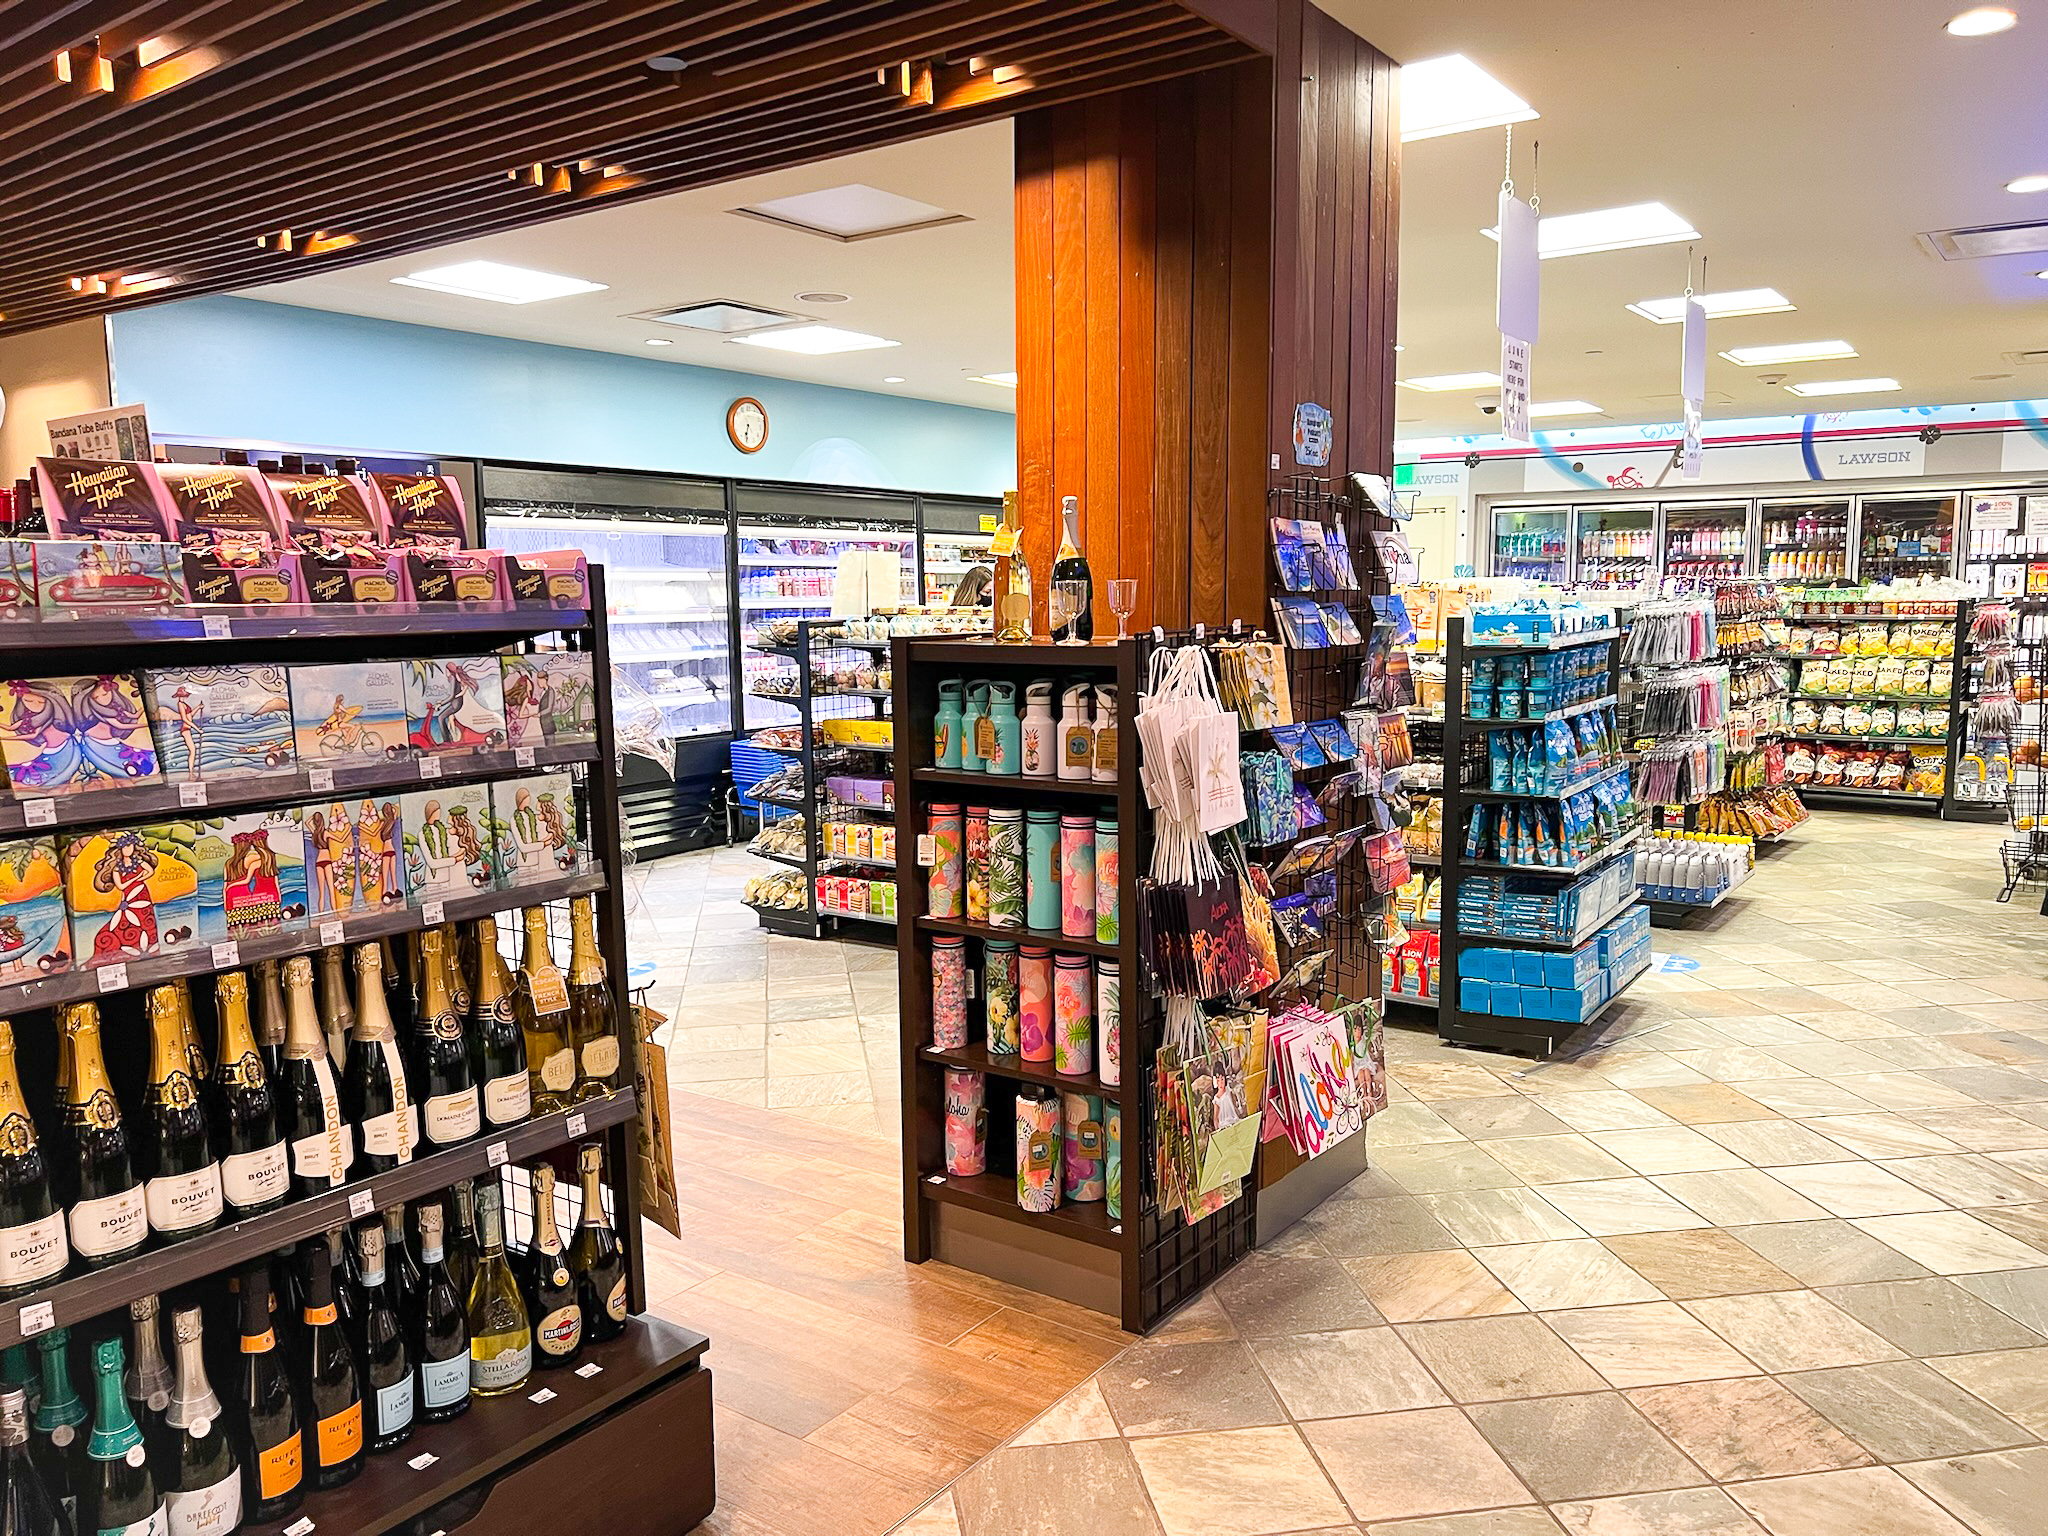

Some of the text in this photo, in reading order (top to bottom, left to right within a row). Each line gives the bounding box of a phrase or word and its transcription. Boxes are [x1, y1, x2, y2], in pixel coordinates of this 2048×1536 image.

[1508, 345, 1524, 358] LINE
[50, 420, 114, 439] Bandana Tube Buffs
[1838, 451, 1911, 466] LAWSON
[65, 465, 128, 496] Hawaiian
[179, 470, 236, 498] Hawaiian
[289, 476, 340, 501] Hawaiian
[87, 478, 135, 510] Host
[200, 481, 243, 510] Host
[308, 484, 347, 512] Host
[392, 479, 438, 506] Hawaiian
[408, 489, 444, 517] Host
[194, 575, 230, 594] Hawaiian
[206, 582, 232, 602] Host
[312, 575, 344, 593] Hawaiian
[322, 582, 346, 601] Host
[418, 575, 448, 592] Hawaiian
[426, 581, 450, 599] Host
[515, 574, 541, 591] Hawaiian
[522, 581, 542, 597] Host
[158, 872, 188, 883] GALLERY
[160, 865, 187, 875] ALOHA
[1402, 948, 1422, 959] LION
[1057, 995, 1075, 1008] loha
[496, 1092, 519, 1103] DOMAINE
[393, 1076, 410, 1158] CHANDON
[436, 1113, 461, 1122] DOMAINE
[324, 1094, 343, 1180] CHANDON
[247, 1162, 285, 1181] BOUVET
[171, 1186, 215, 1205] BOUVET
[100, 1207, 142, 1229] BOUVET
[10, 1237, 59, 1259] BOUVET
[544, 1325, 567, 1340] MARTINI
[482, 1355, 528, 1375] STELLA ROSA
[271, 1444, 300, 1464] RUFFIN
[186, 1501, 227, 1523] BAREFOOT
